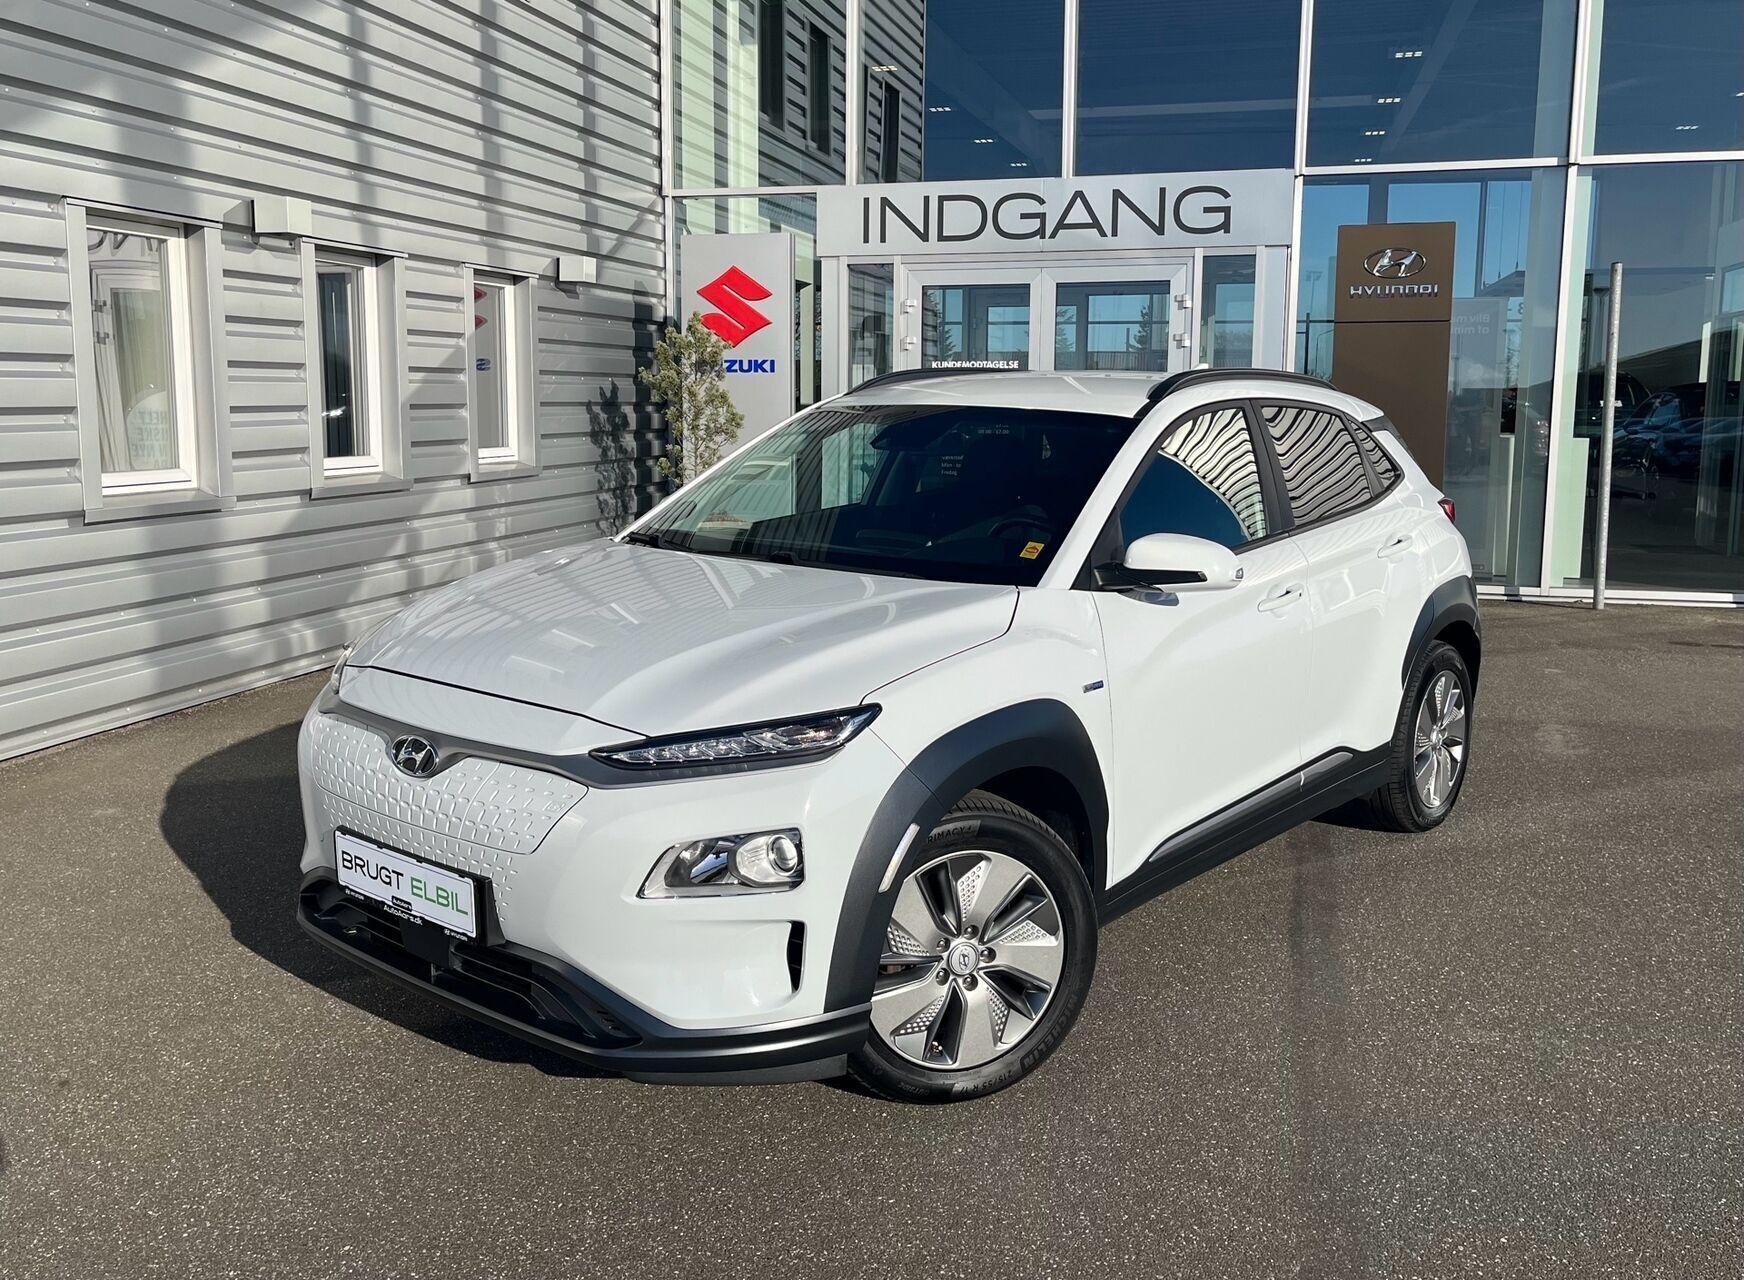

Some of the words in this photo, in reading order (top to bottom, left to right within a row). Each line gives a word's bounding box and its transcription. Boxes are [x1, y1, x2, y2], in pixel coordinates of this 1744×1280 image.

[862, 186, 1232, 244] INDGANG
[1350, 284, 1438, 297] HYUNDAI
[723, 359, 776, 374] ZUKI
[927, 827, 965, 844] RIMACY
[341, 850, 404, 890] BRUGT
[410, 876, 469, 916] ELBIL
